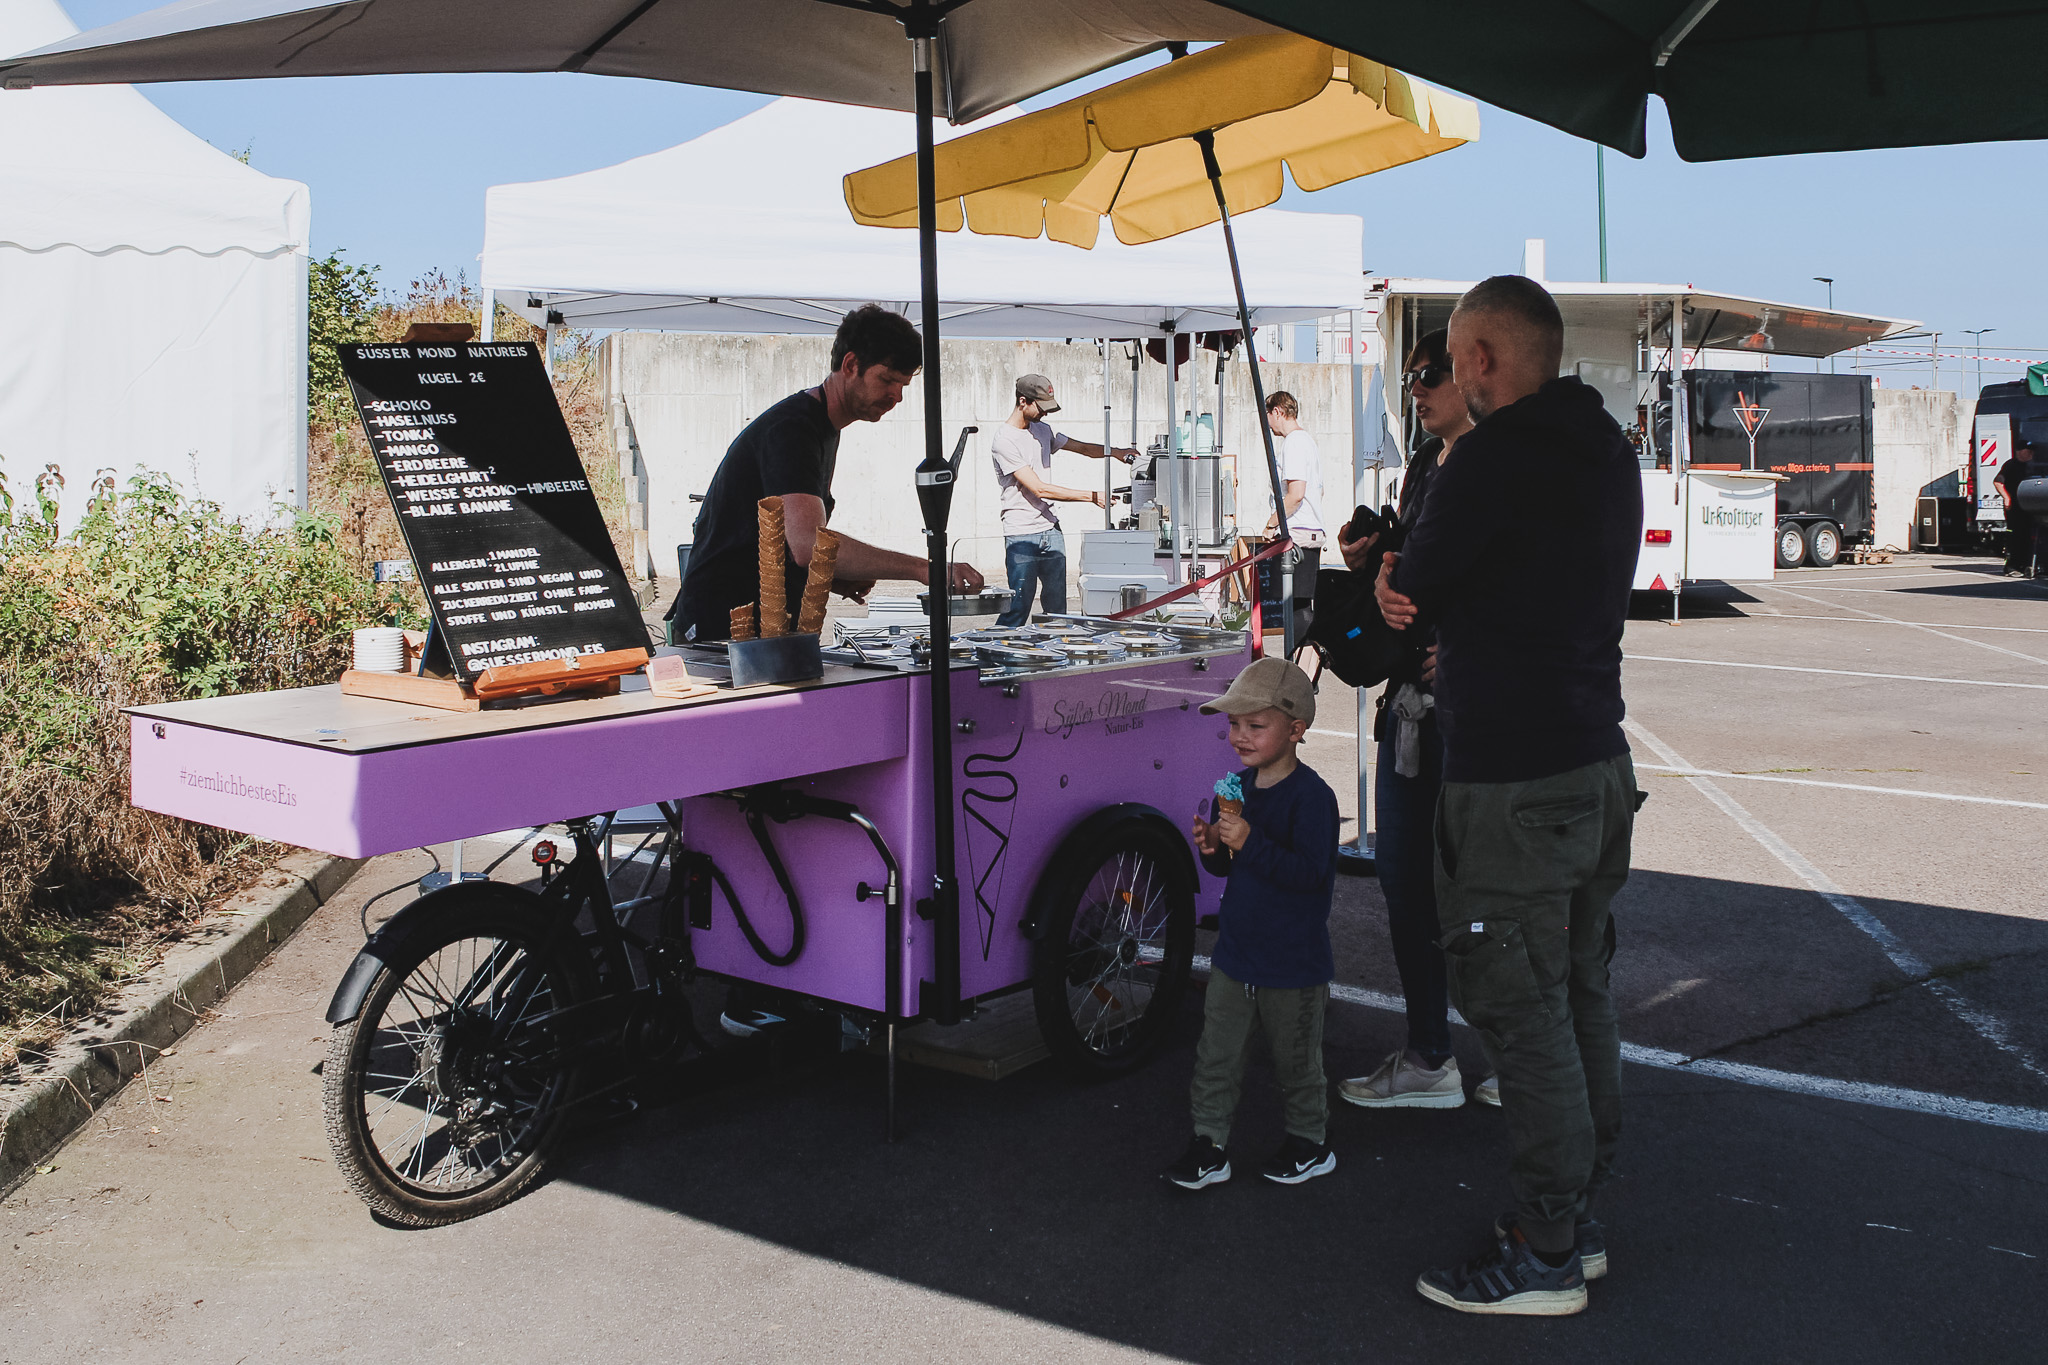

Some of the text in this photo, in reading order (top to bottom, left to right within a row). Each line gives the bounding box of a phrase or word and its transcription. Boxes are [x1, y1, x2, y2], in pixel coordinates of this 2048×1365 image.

[357, 344, 528, 359] SÜSSER MOND NATUREIS
[418, 371, 486, 384] KUGEL 2€
[459, 500, 513, 514] BANANE
[433, 569, 604, 595] ALLE SORTEN SIND VEGAN UND
[440, 584, 609, 611] ZUCKERREDUZIERT OHNE FARB-
[446, 613, 487, 626] STOFFE
[490, 609, 518, 622] UND
[573, 598, 615, 612] AROMEN
[461, 635, 540, 657] INSTAGRAM:
[1045, 689, 1149, 739] Süßer Mond
[1105, 716, 1144, 737] Natur-Eis
[180, 765, 297, 807] #ziemlichbestesEis
